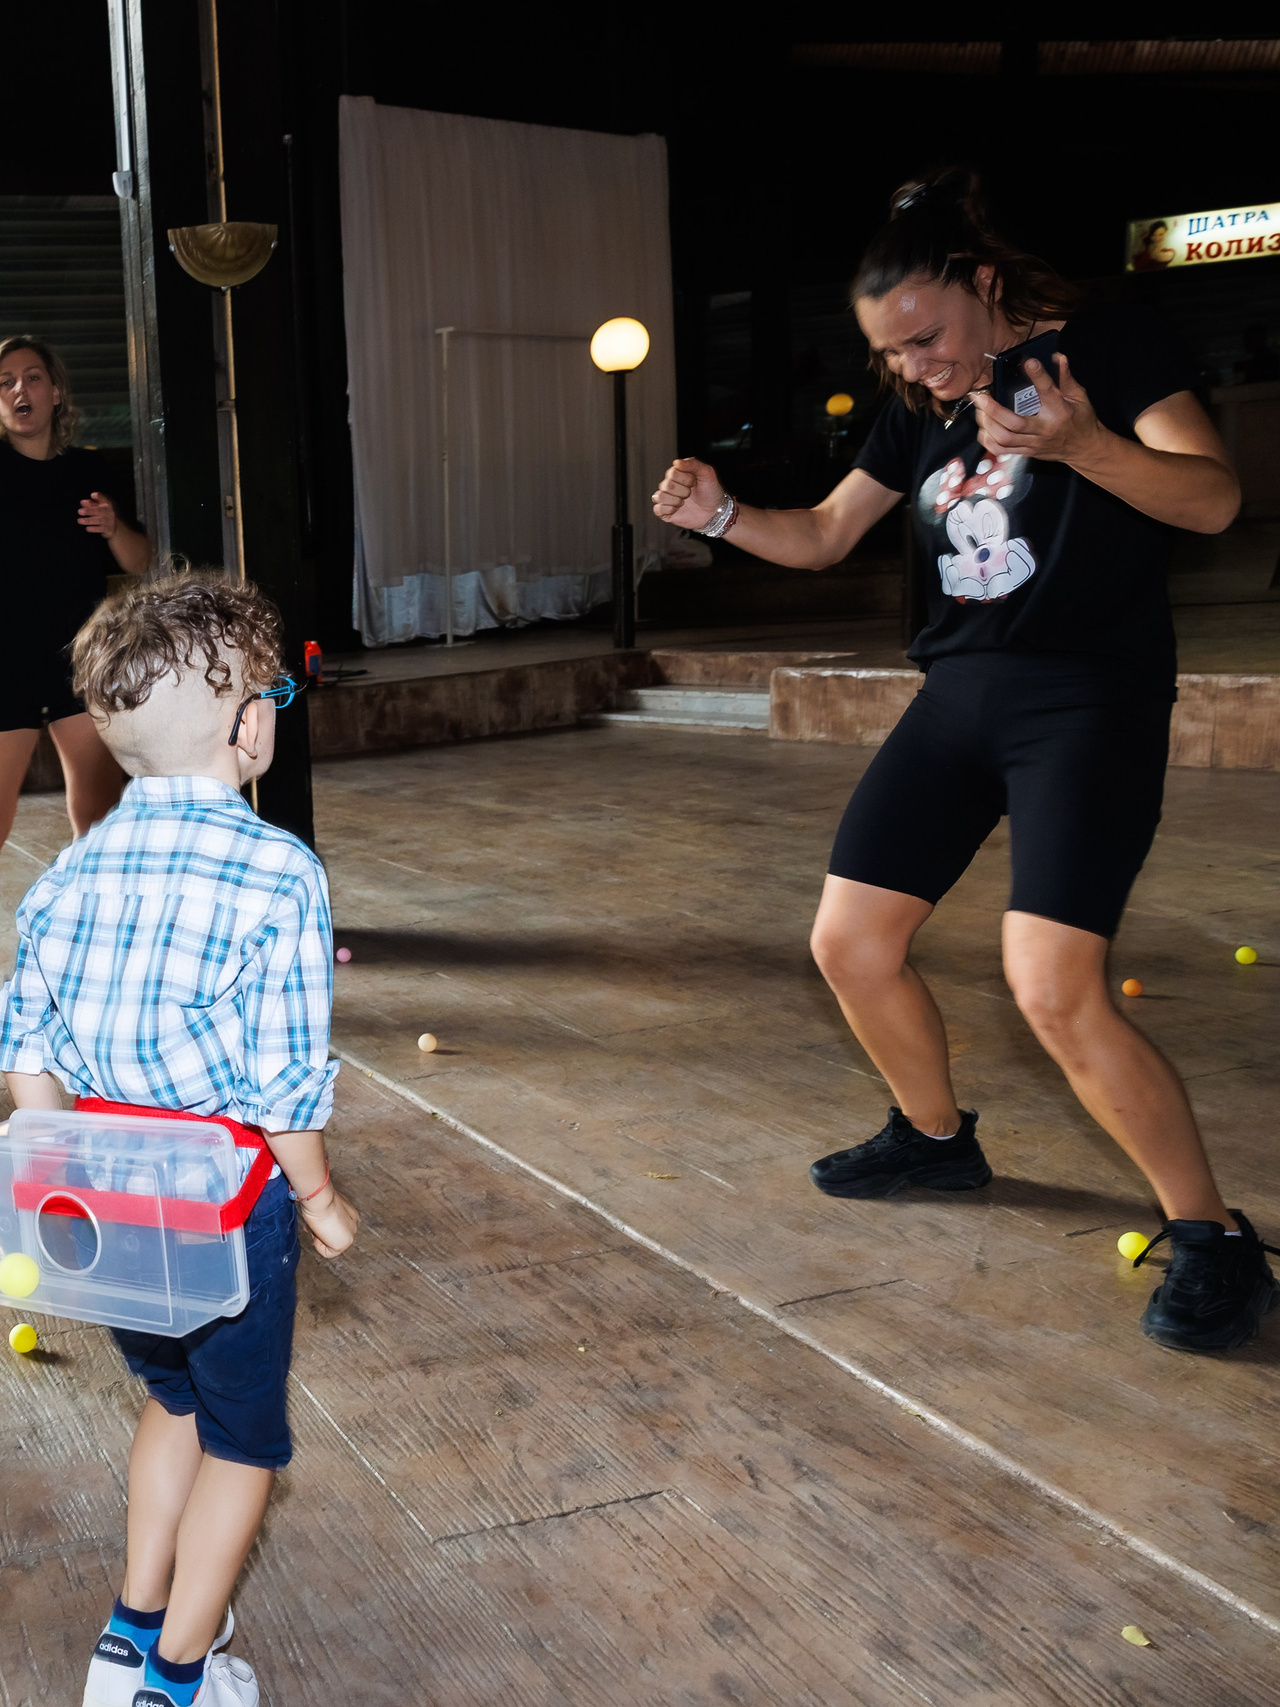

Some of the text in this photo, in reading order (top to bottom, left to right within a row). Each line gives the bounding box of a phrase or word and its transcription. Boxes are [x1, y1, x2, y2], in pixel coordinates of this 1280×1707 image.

[1187, 210, 1270, 236] ШАТРА
[1185, 232, 1280, 262] КОЛИЗ
[99, 1643, 128, 1657] adidas
